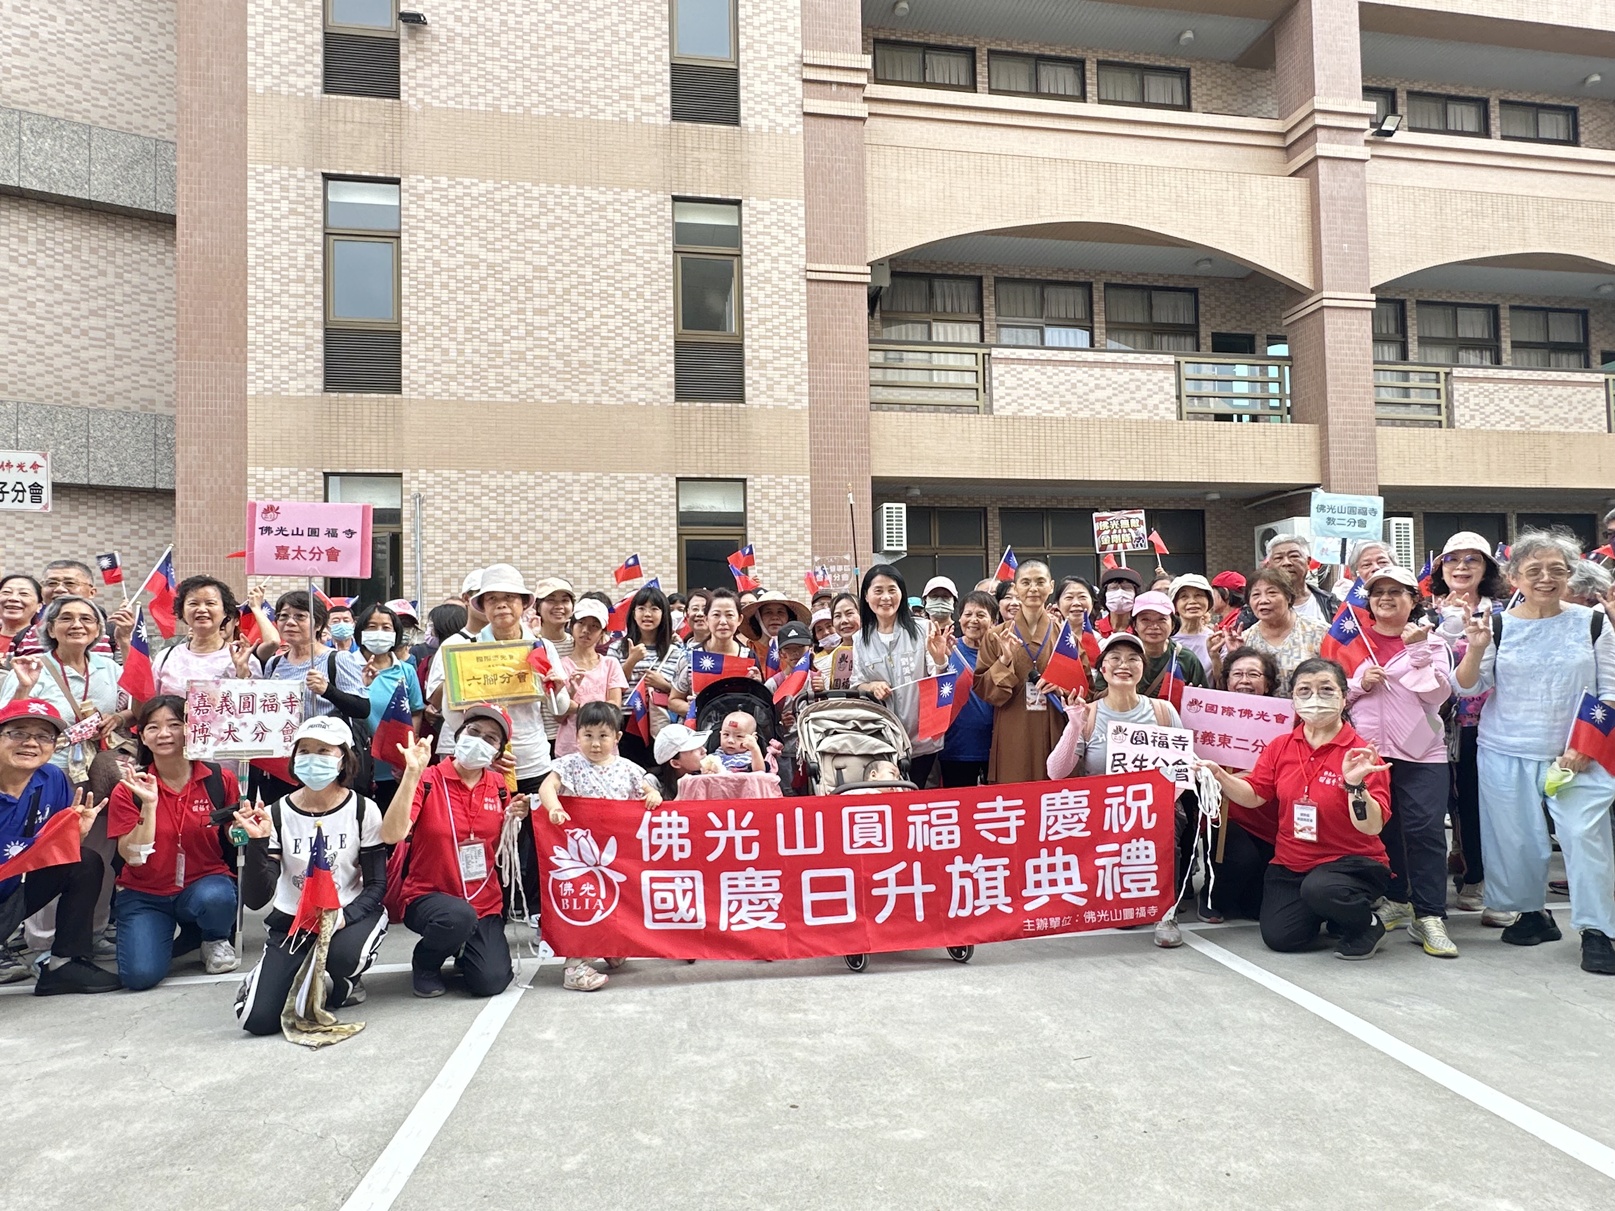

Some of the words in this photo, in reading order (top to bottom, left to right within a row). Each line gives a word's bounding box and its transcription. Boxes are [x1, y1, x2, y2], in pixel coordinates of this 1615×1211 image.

[1316, 504, 1378, 517] 佛光山圓福寺
[1326, 516, 1367, 528] 教二分會
[258, 525, 358, 539] 佛光山圓福寺
[274, 545, 342, 562] 嘉太分會
[466, 671, 529, 686] 六腳分會
[192, 690, 300, 716] 嘉義圓福寺
[1204, 702, 1290, 725] 國際佛光會
[191, 720, 300, 745] 博大分會
[1130, 730, 1189, 751] 圓福寺
[635, 783, 1158, 862] 佛光山圓福寺慶祝
[559, 881, 597, 897] 佛光
[640, 837, 1160, 932] 國慶日升旗典禮
[561, 898, 605, 910] BLIA
